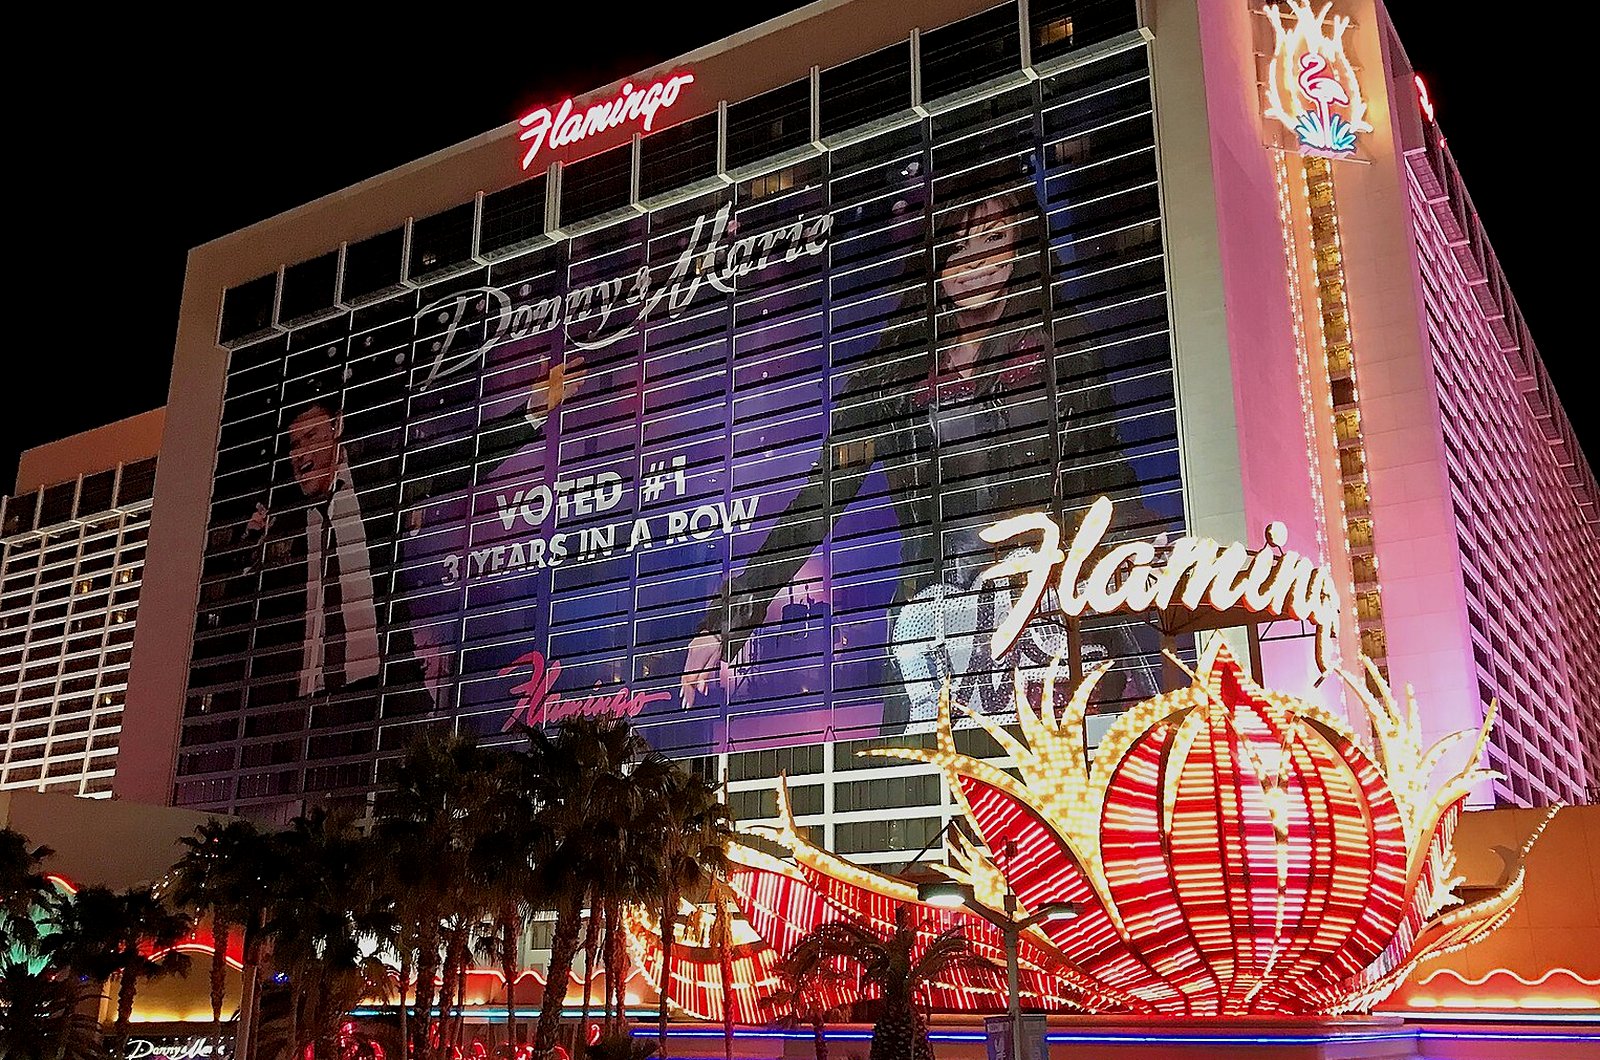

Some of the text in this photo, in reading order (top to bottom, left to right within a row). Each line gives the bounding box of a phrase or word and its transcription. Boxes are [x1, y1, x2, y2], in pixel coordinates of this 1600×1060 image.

[518, 73, 694, 170] Flamingo
[408, 276, 641, 391] Donny
[645, 199, 834, 320] Marie
[497, 456, 687, 531] VOTED #1
[441, 496, 759, 587] 3 YEARS IN A ROW
[978, 495, 1341, 674] Flaming
[497, 650, 672, 733] Flamingo
